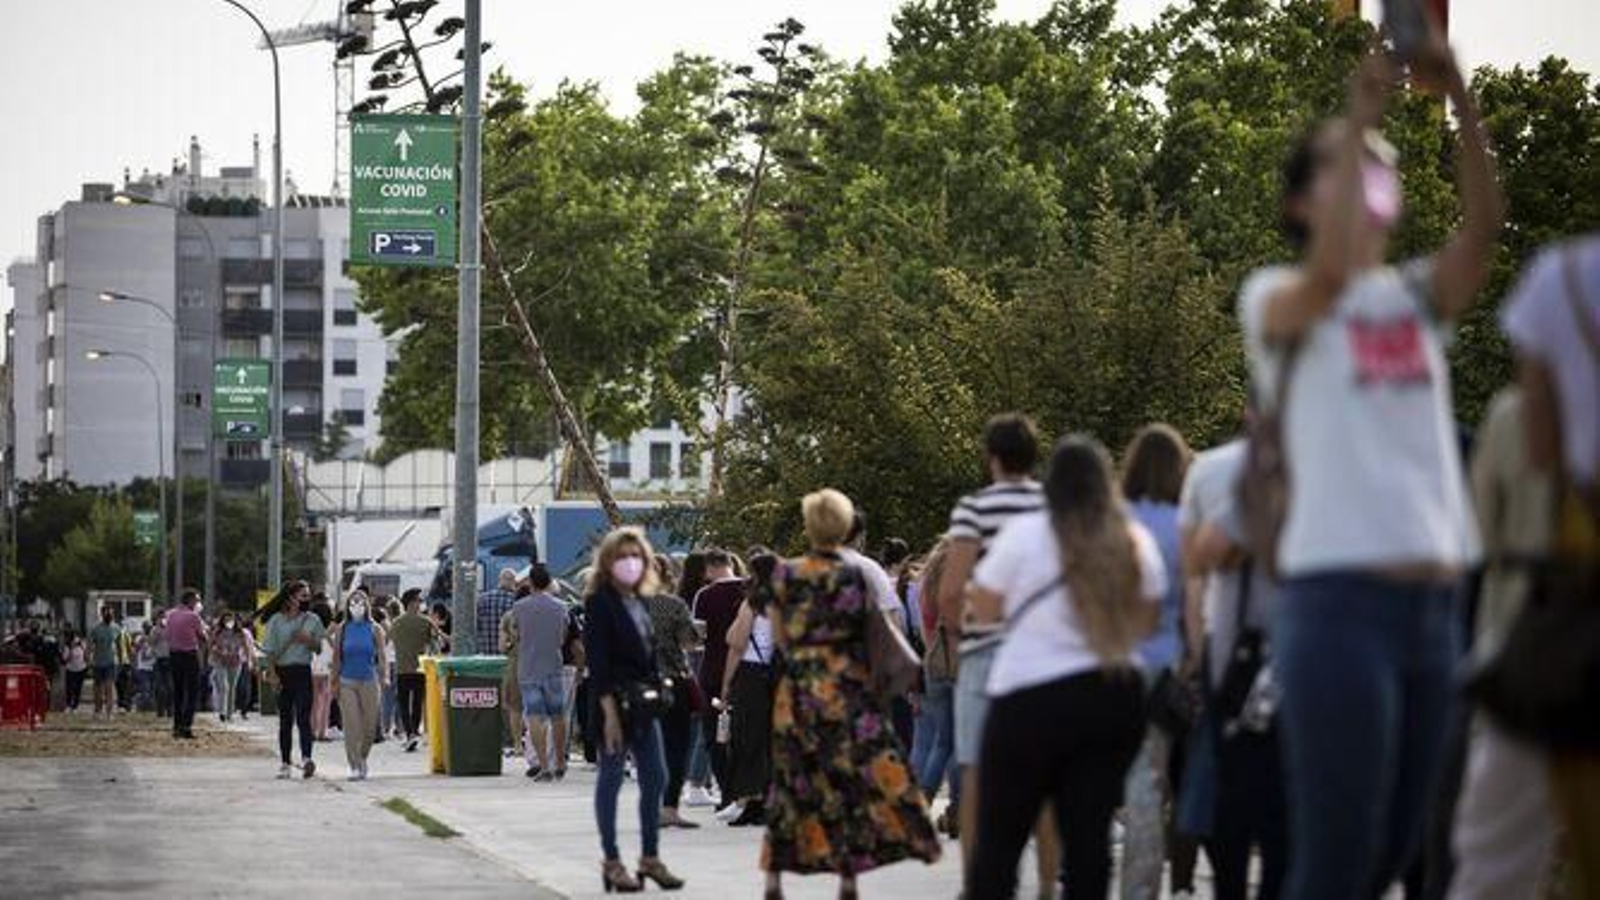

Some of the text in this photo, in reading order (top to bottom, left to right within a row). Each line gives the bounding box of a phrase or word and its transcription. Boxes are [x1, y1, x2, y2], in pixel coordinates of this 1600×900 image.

[354, 164, 453, 180] VACUNACIÓN
[380, 183, 427, 197] COVID
[375, 234, 391, 253] P
